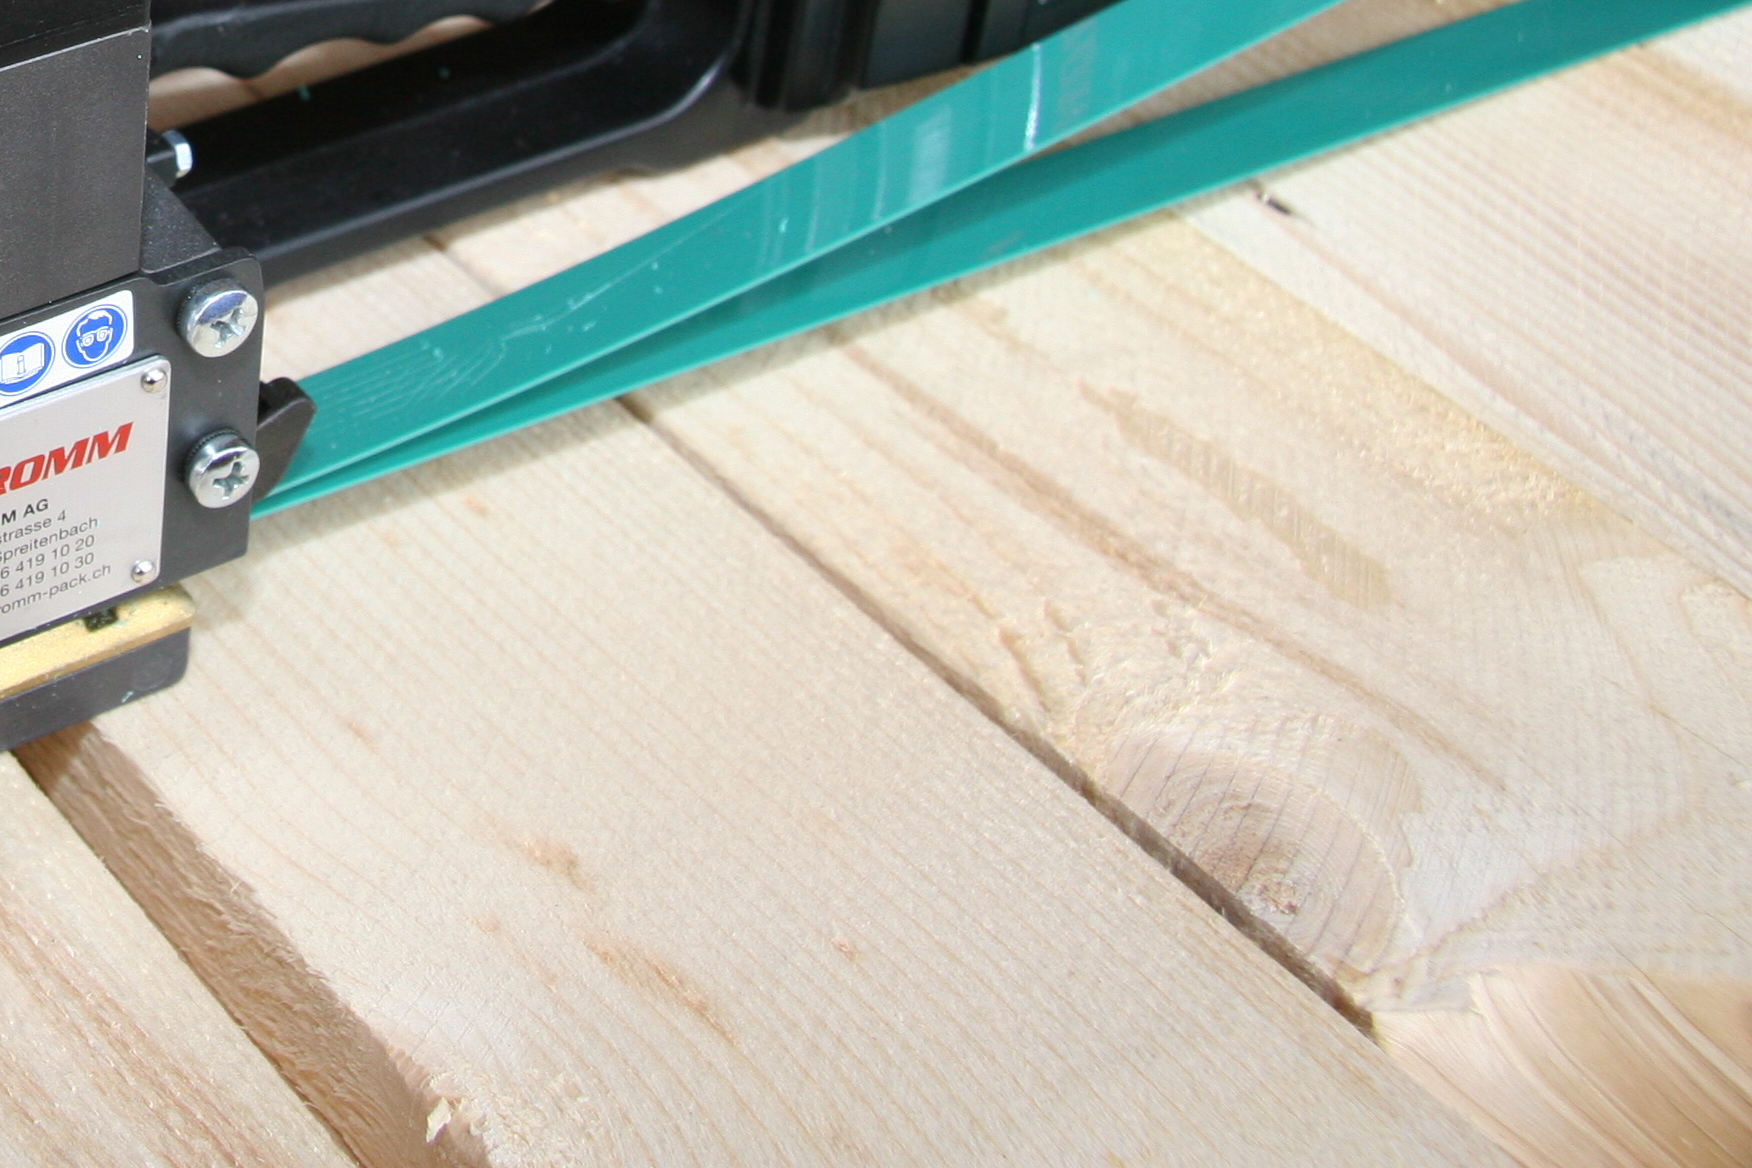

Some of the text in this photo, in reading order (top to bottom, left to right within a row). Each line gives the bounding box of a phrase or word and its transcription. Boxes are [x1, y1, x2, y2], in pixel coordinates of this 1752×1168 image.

[23, 498, 49, 518] AG
[57, 509, 67, 523] 4
[15, 554, 45, 572] 419
[52, 544, 70, 560] 10
[75, 534, 95, 552] 20
[15, 571, 45, 590] 419
[52, 562, 69, 578] 10
[74, 552, 94, 570] 30
